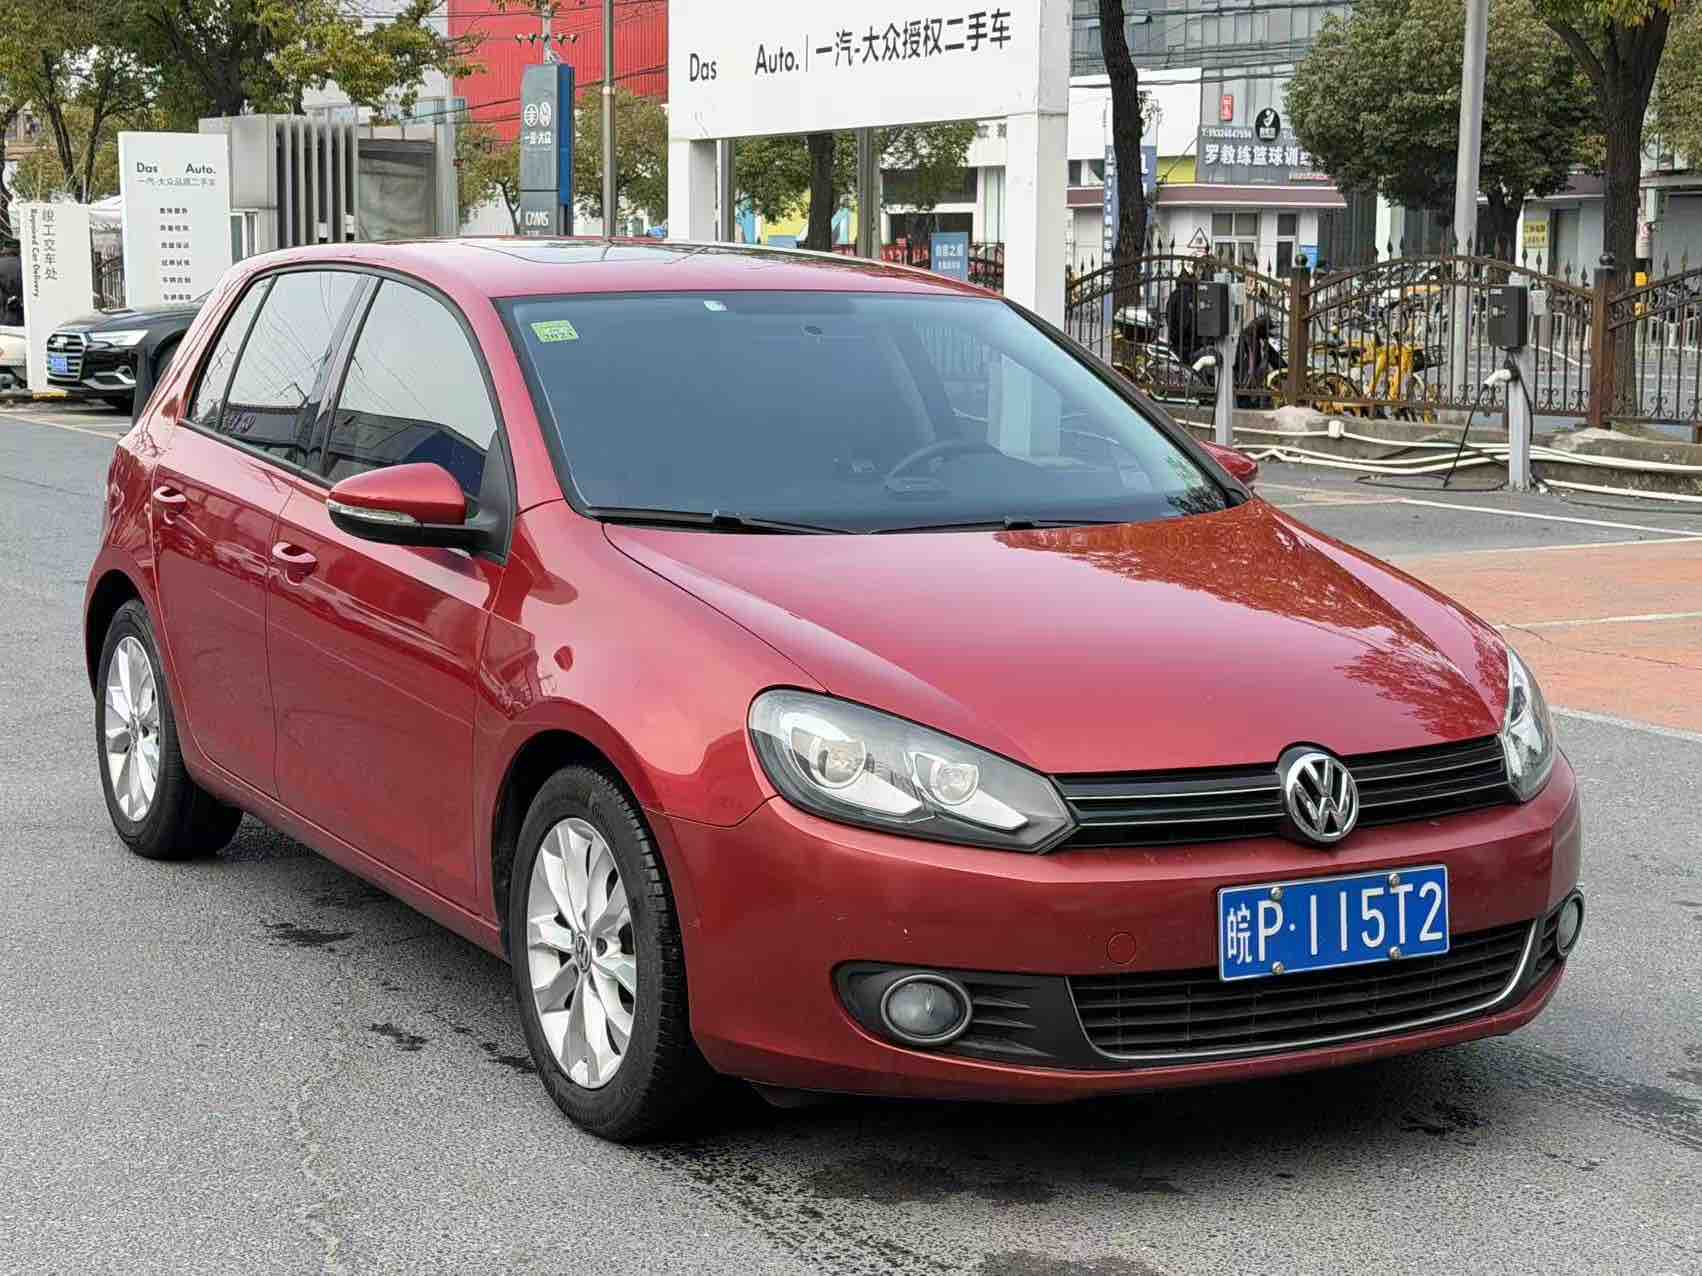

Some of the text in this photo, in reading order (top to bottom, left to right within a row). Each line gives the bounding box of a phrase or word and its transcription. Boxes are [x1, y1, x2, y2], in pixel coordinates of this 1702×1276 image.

[815, 8, 1012, 67] 一汽-大众授权二手车
[688, 44, 800, 82] Das Auto.
[136, 162, 216, 174] Das Auto.
